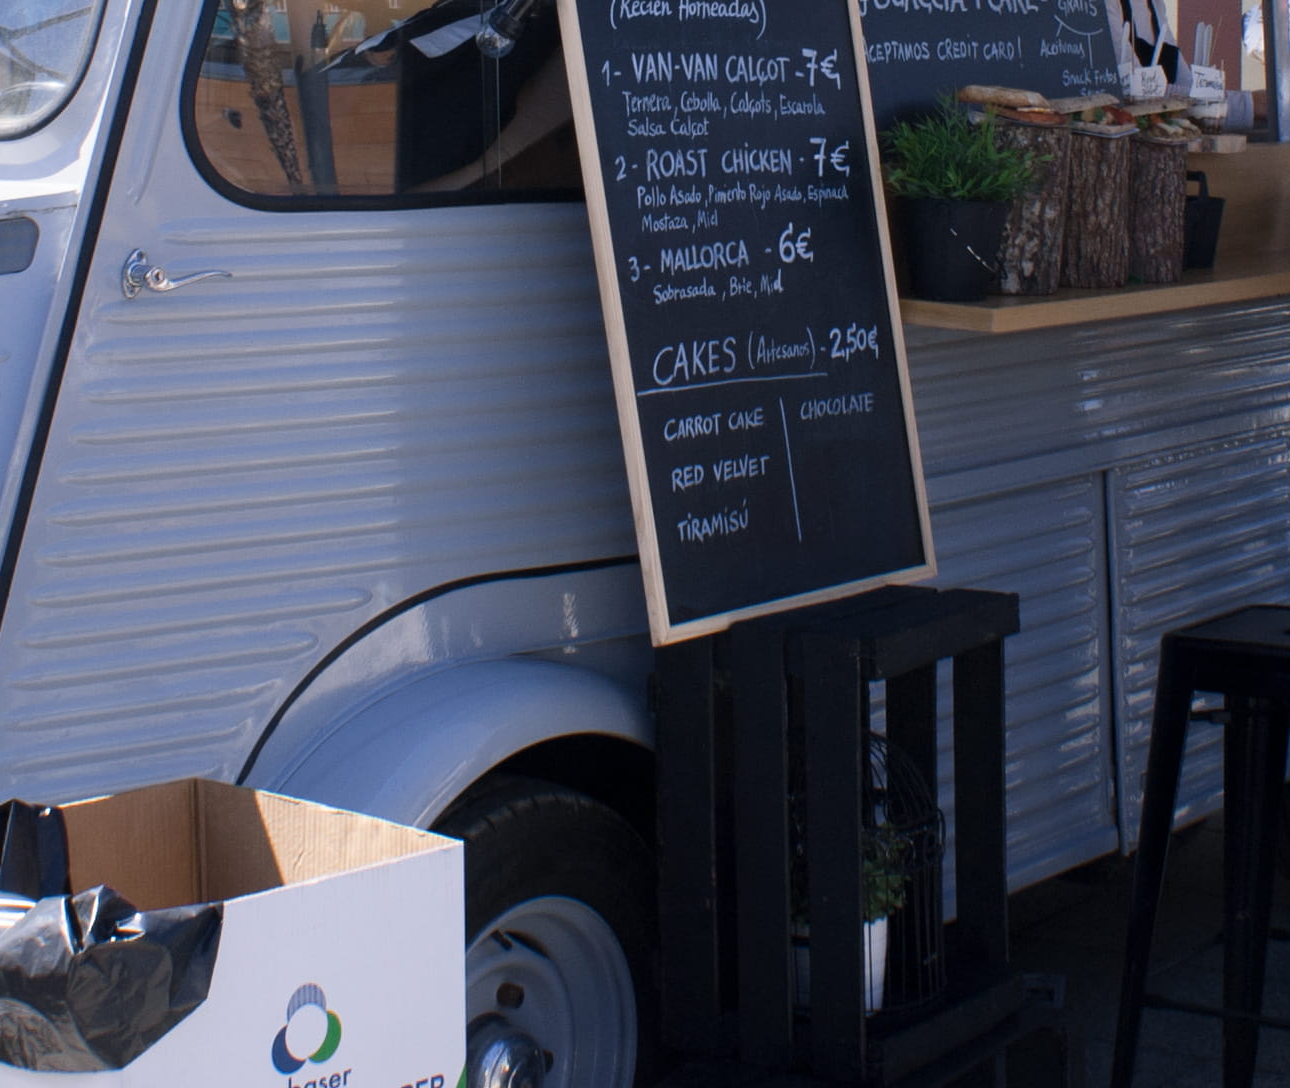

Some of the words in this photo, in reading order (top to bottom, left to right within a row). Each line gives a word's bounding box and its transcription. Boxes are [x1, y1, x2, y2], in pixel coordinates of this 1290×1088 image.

[646, 148, 708, 181] ROAST
[637, 185, 666, 209] Pollo
[660, 239, 750, 276] MALLORCA
[653, 336, 737, 385] CAKES
[800, 392, 874, 420] CHOCOLATE
[663, 412, 722, 442] CARROT
[728, 407, 764, 430] CAKE
[671, 465, 705, 493] RED
[713, 453, 770, 482] VELVET
